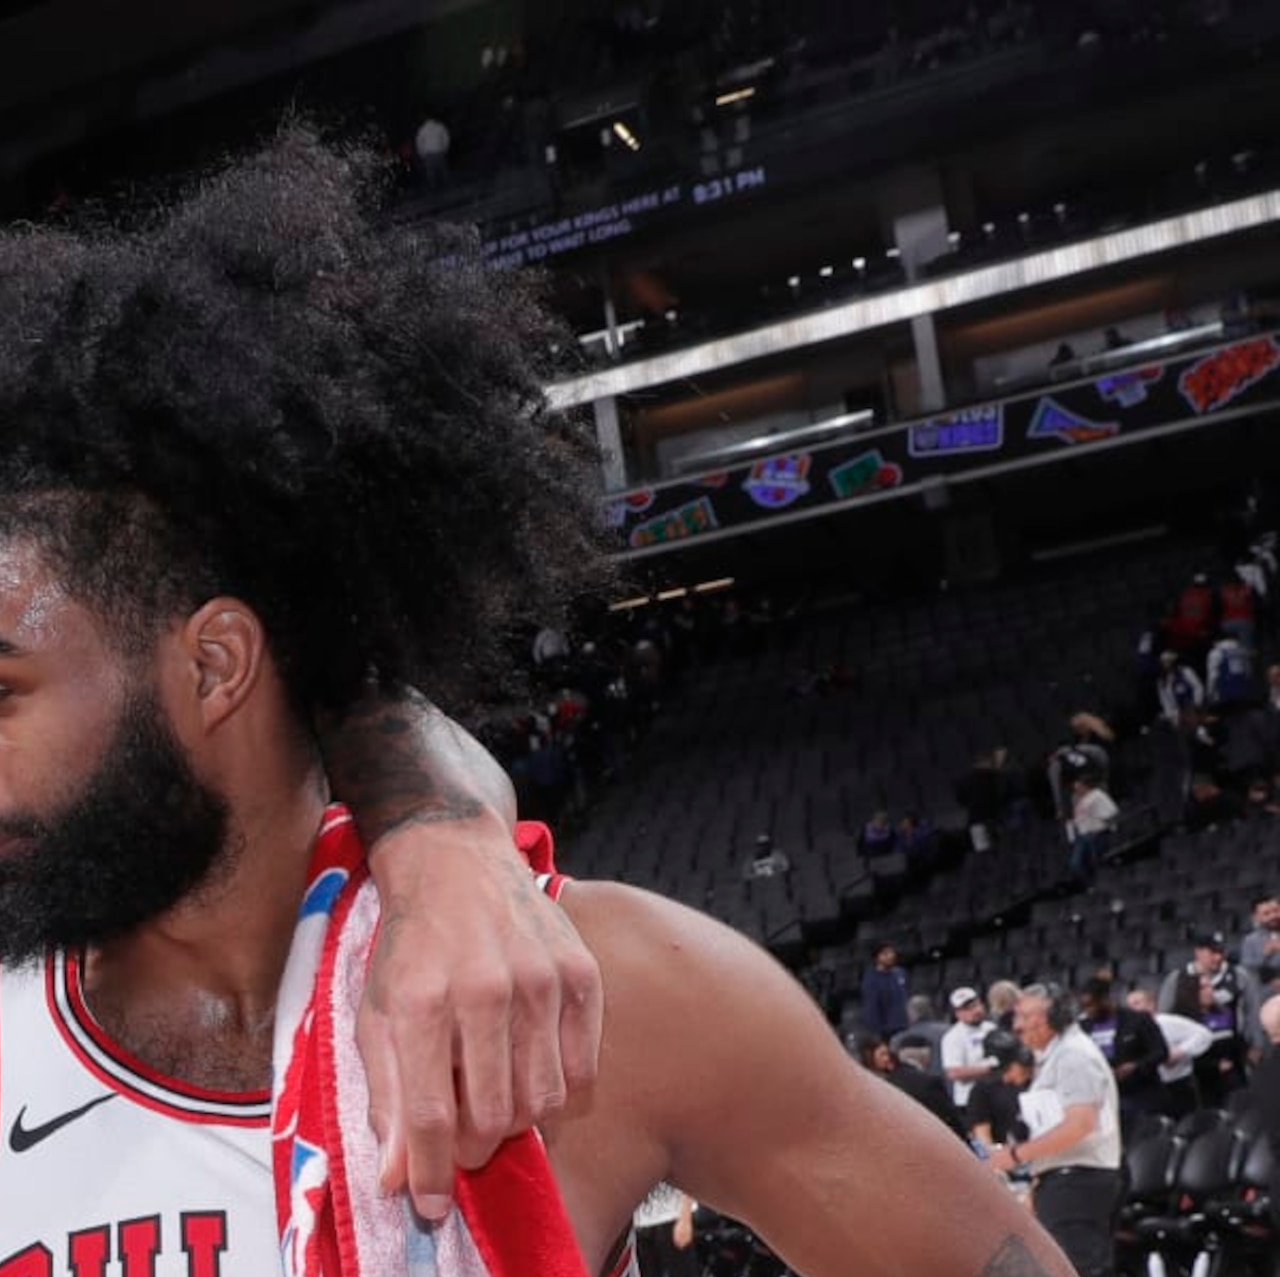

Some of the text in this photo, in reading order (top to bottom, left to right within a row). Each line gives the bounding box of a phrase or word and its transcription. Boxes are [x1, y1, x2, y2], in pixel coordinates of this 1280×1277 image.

[531, 219, 572, 241] YOUR
[573, 205, 619, 229] KINGS
[737, 167, 765, 189] PM
[527, 243, 547, 260] TO
[549, 231, 585, 253] WAIT
